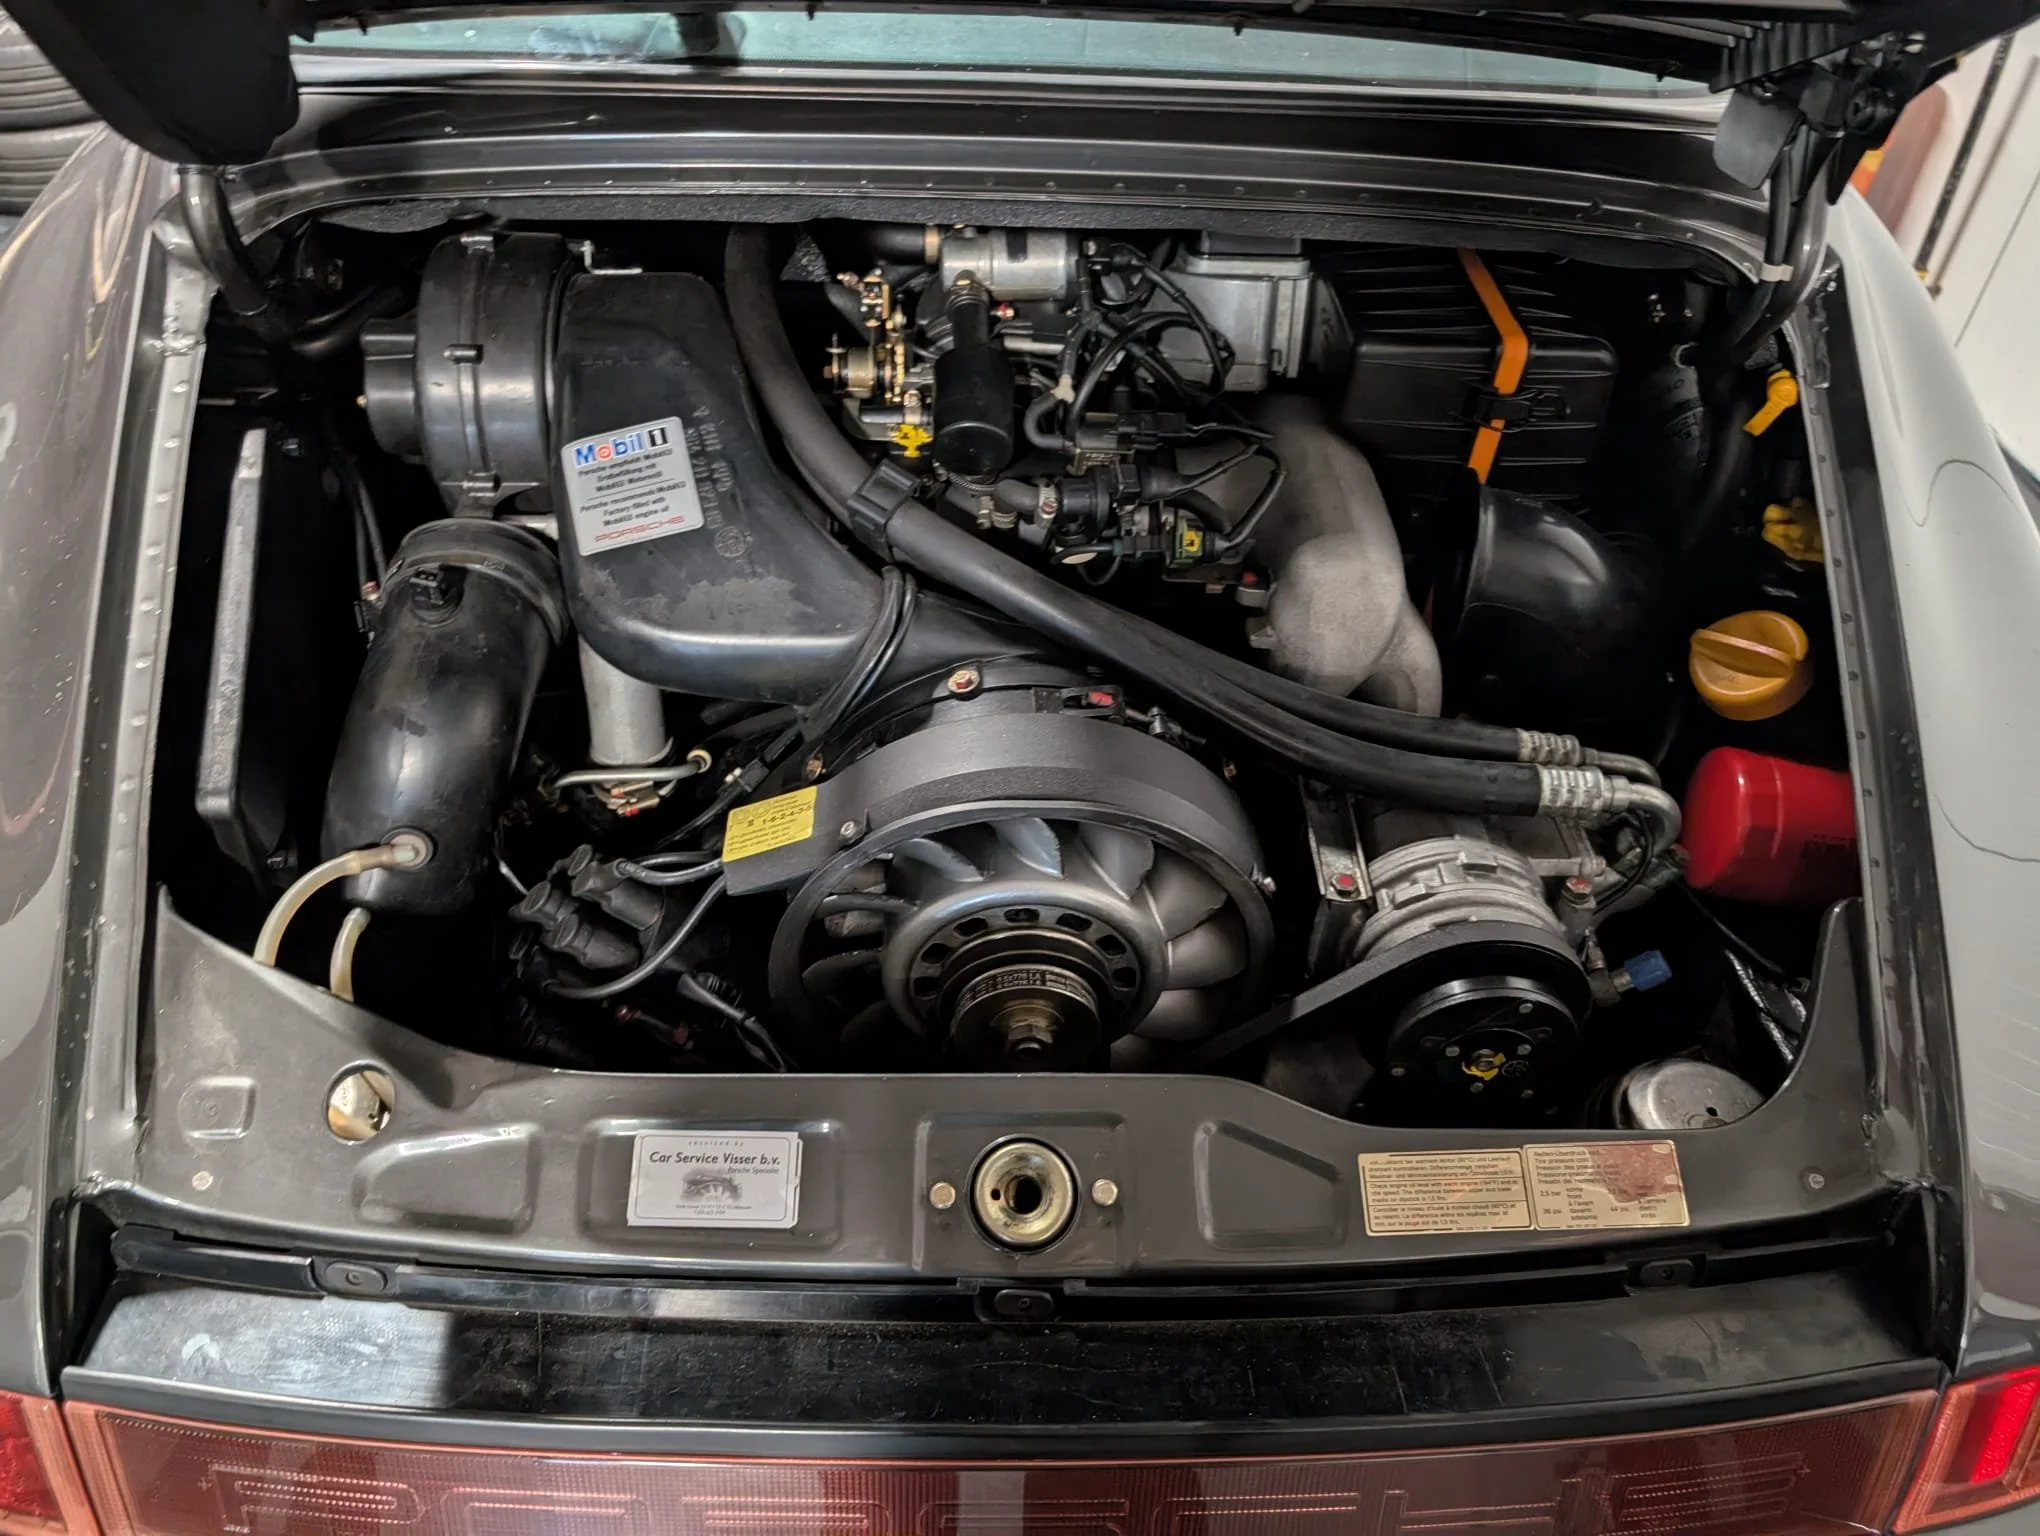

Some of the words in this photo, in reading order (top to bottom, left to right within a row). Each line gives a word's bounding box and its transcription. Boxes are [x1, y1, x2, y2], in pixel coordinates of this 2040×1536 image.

[575, 431, 643, 465] Mobil
[595, 516, 684, 541] PORSCHE
[649, 1151, 672, 1162] Car
[674, 1151, 718, 1163] Service
[722, 1152, 757, 1164] Visser
[760, 1153, 780, 1164] b.v.
